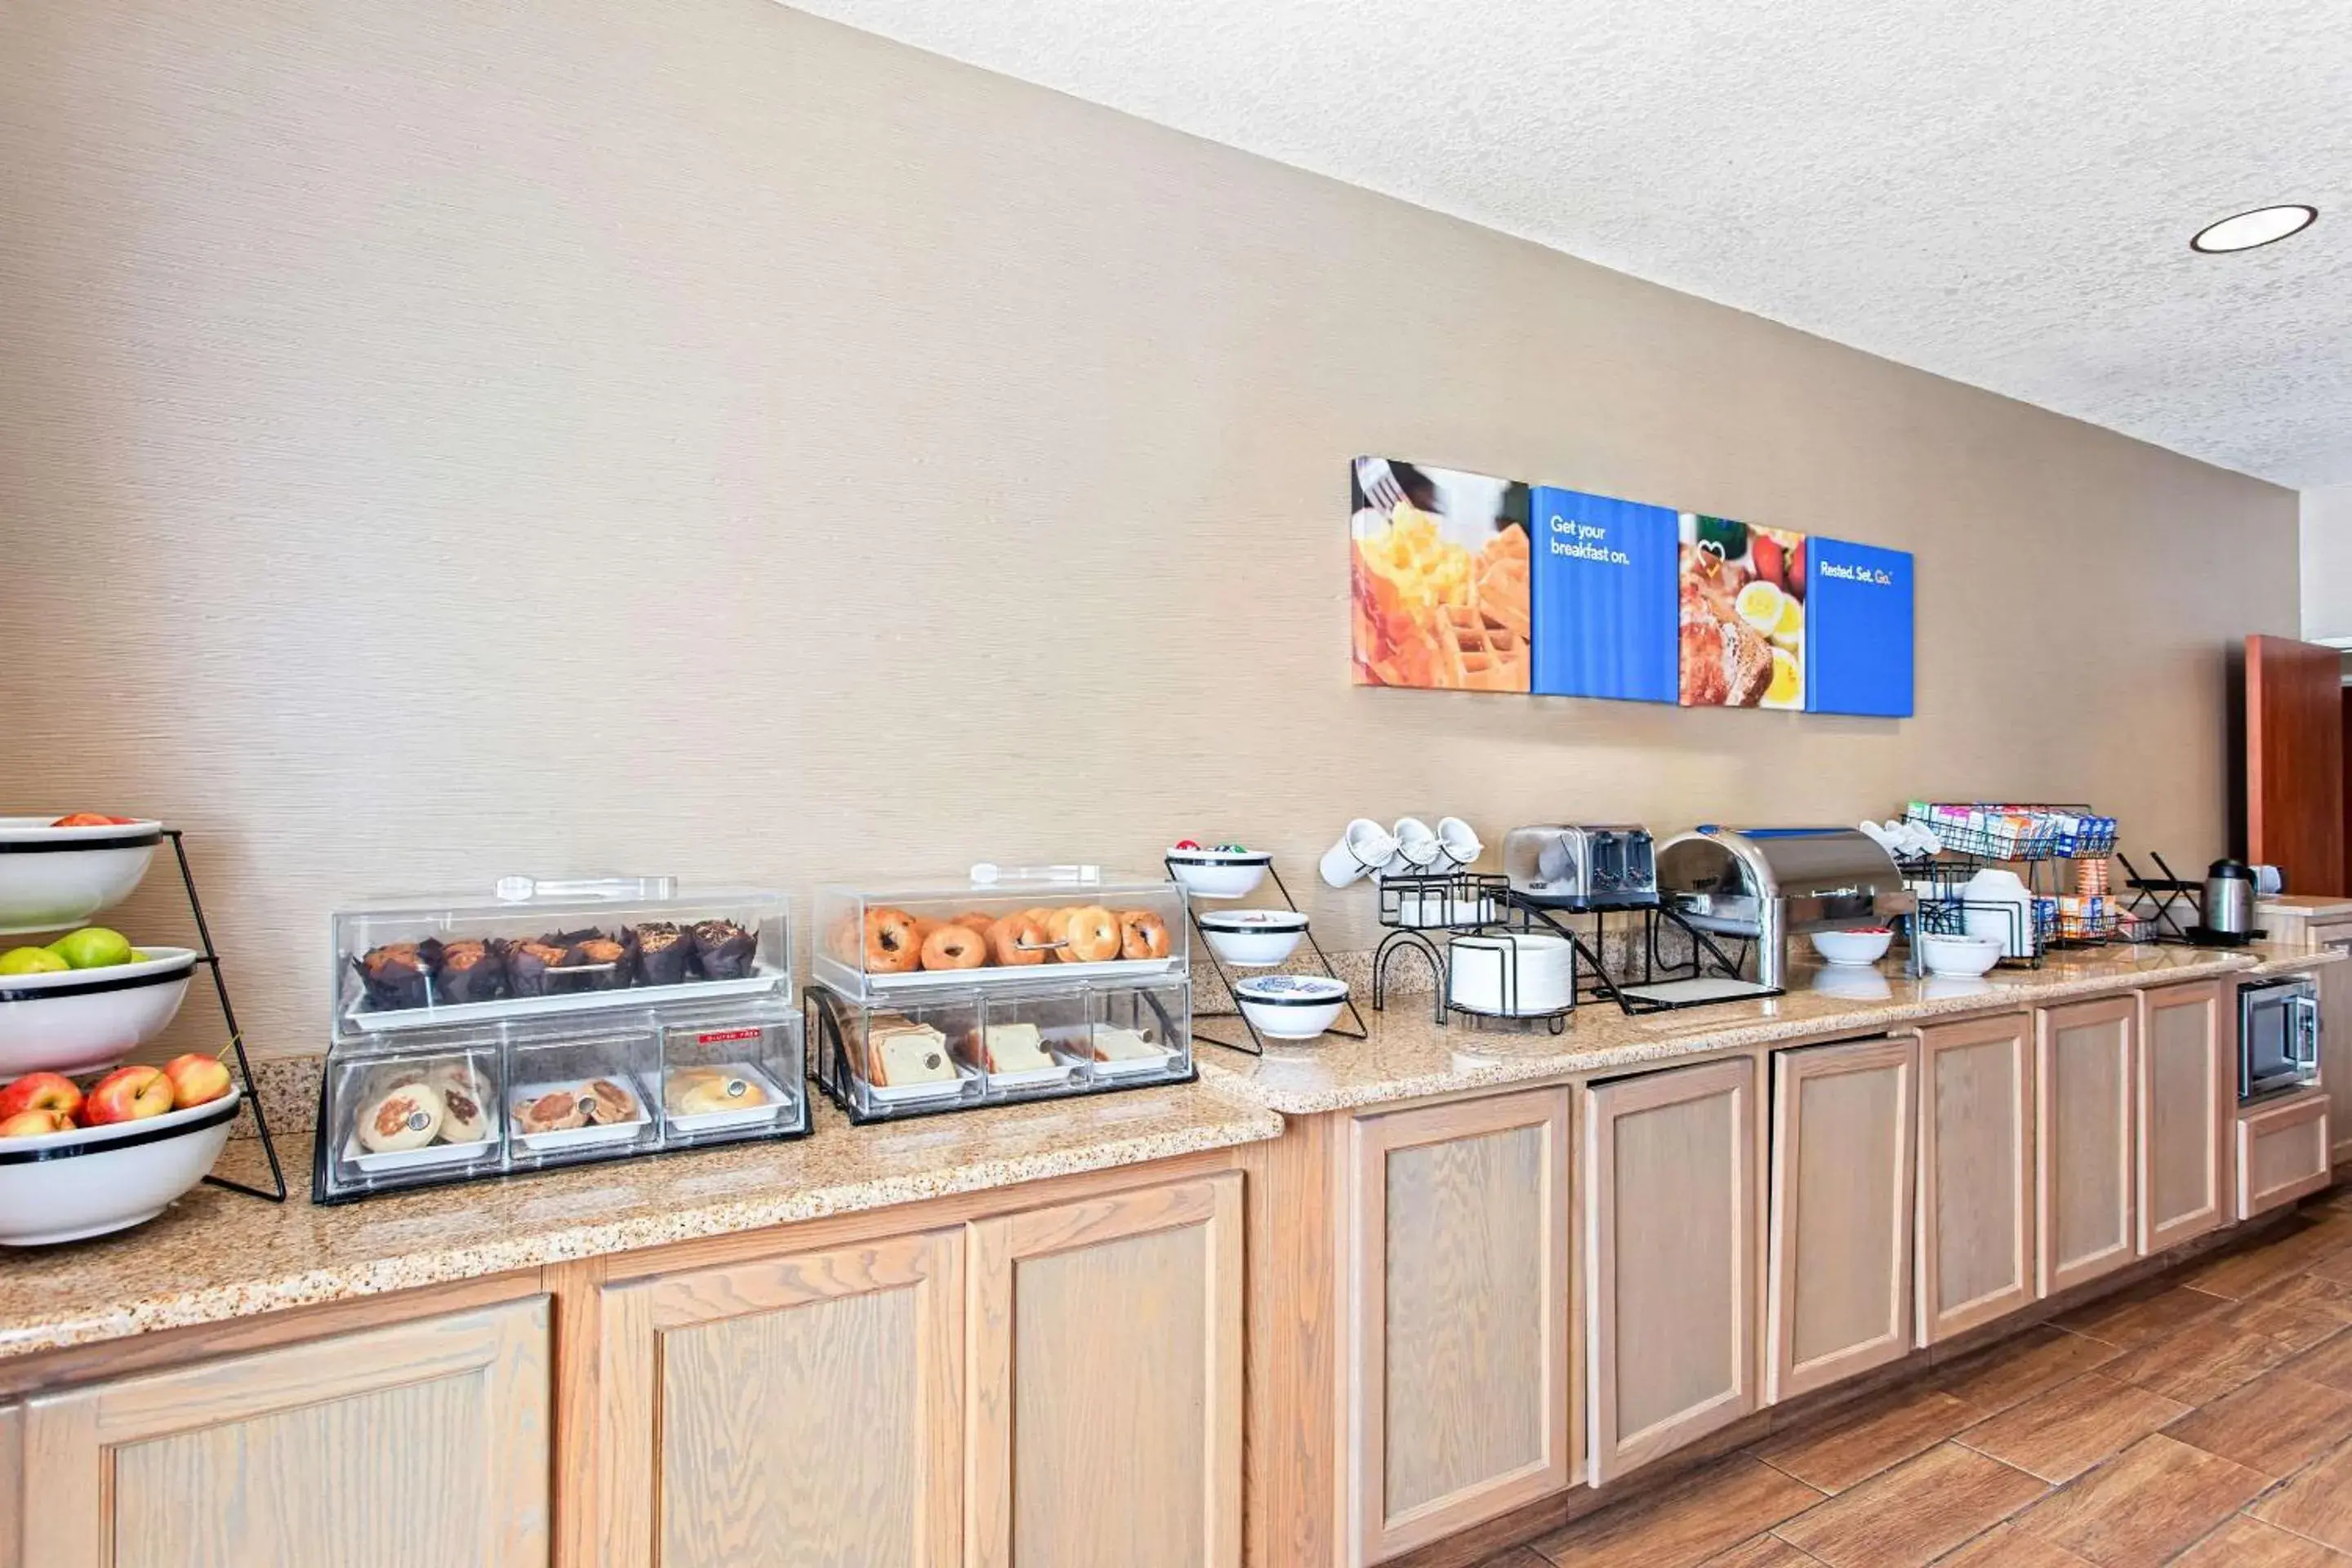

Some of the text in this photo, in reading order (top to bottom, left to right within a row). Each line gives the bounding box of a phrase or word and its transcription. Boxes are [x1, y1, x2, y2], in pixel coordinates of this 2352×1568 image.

[1551, 514, 1606, 540] Get your
[1551, 537, 1630, 565] breakfast on.
[1820, 561, 1855, 579] Rested.
[1856, 565, 1873, 582] Set.
